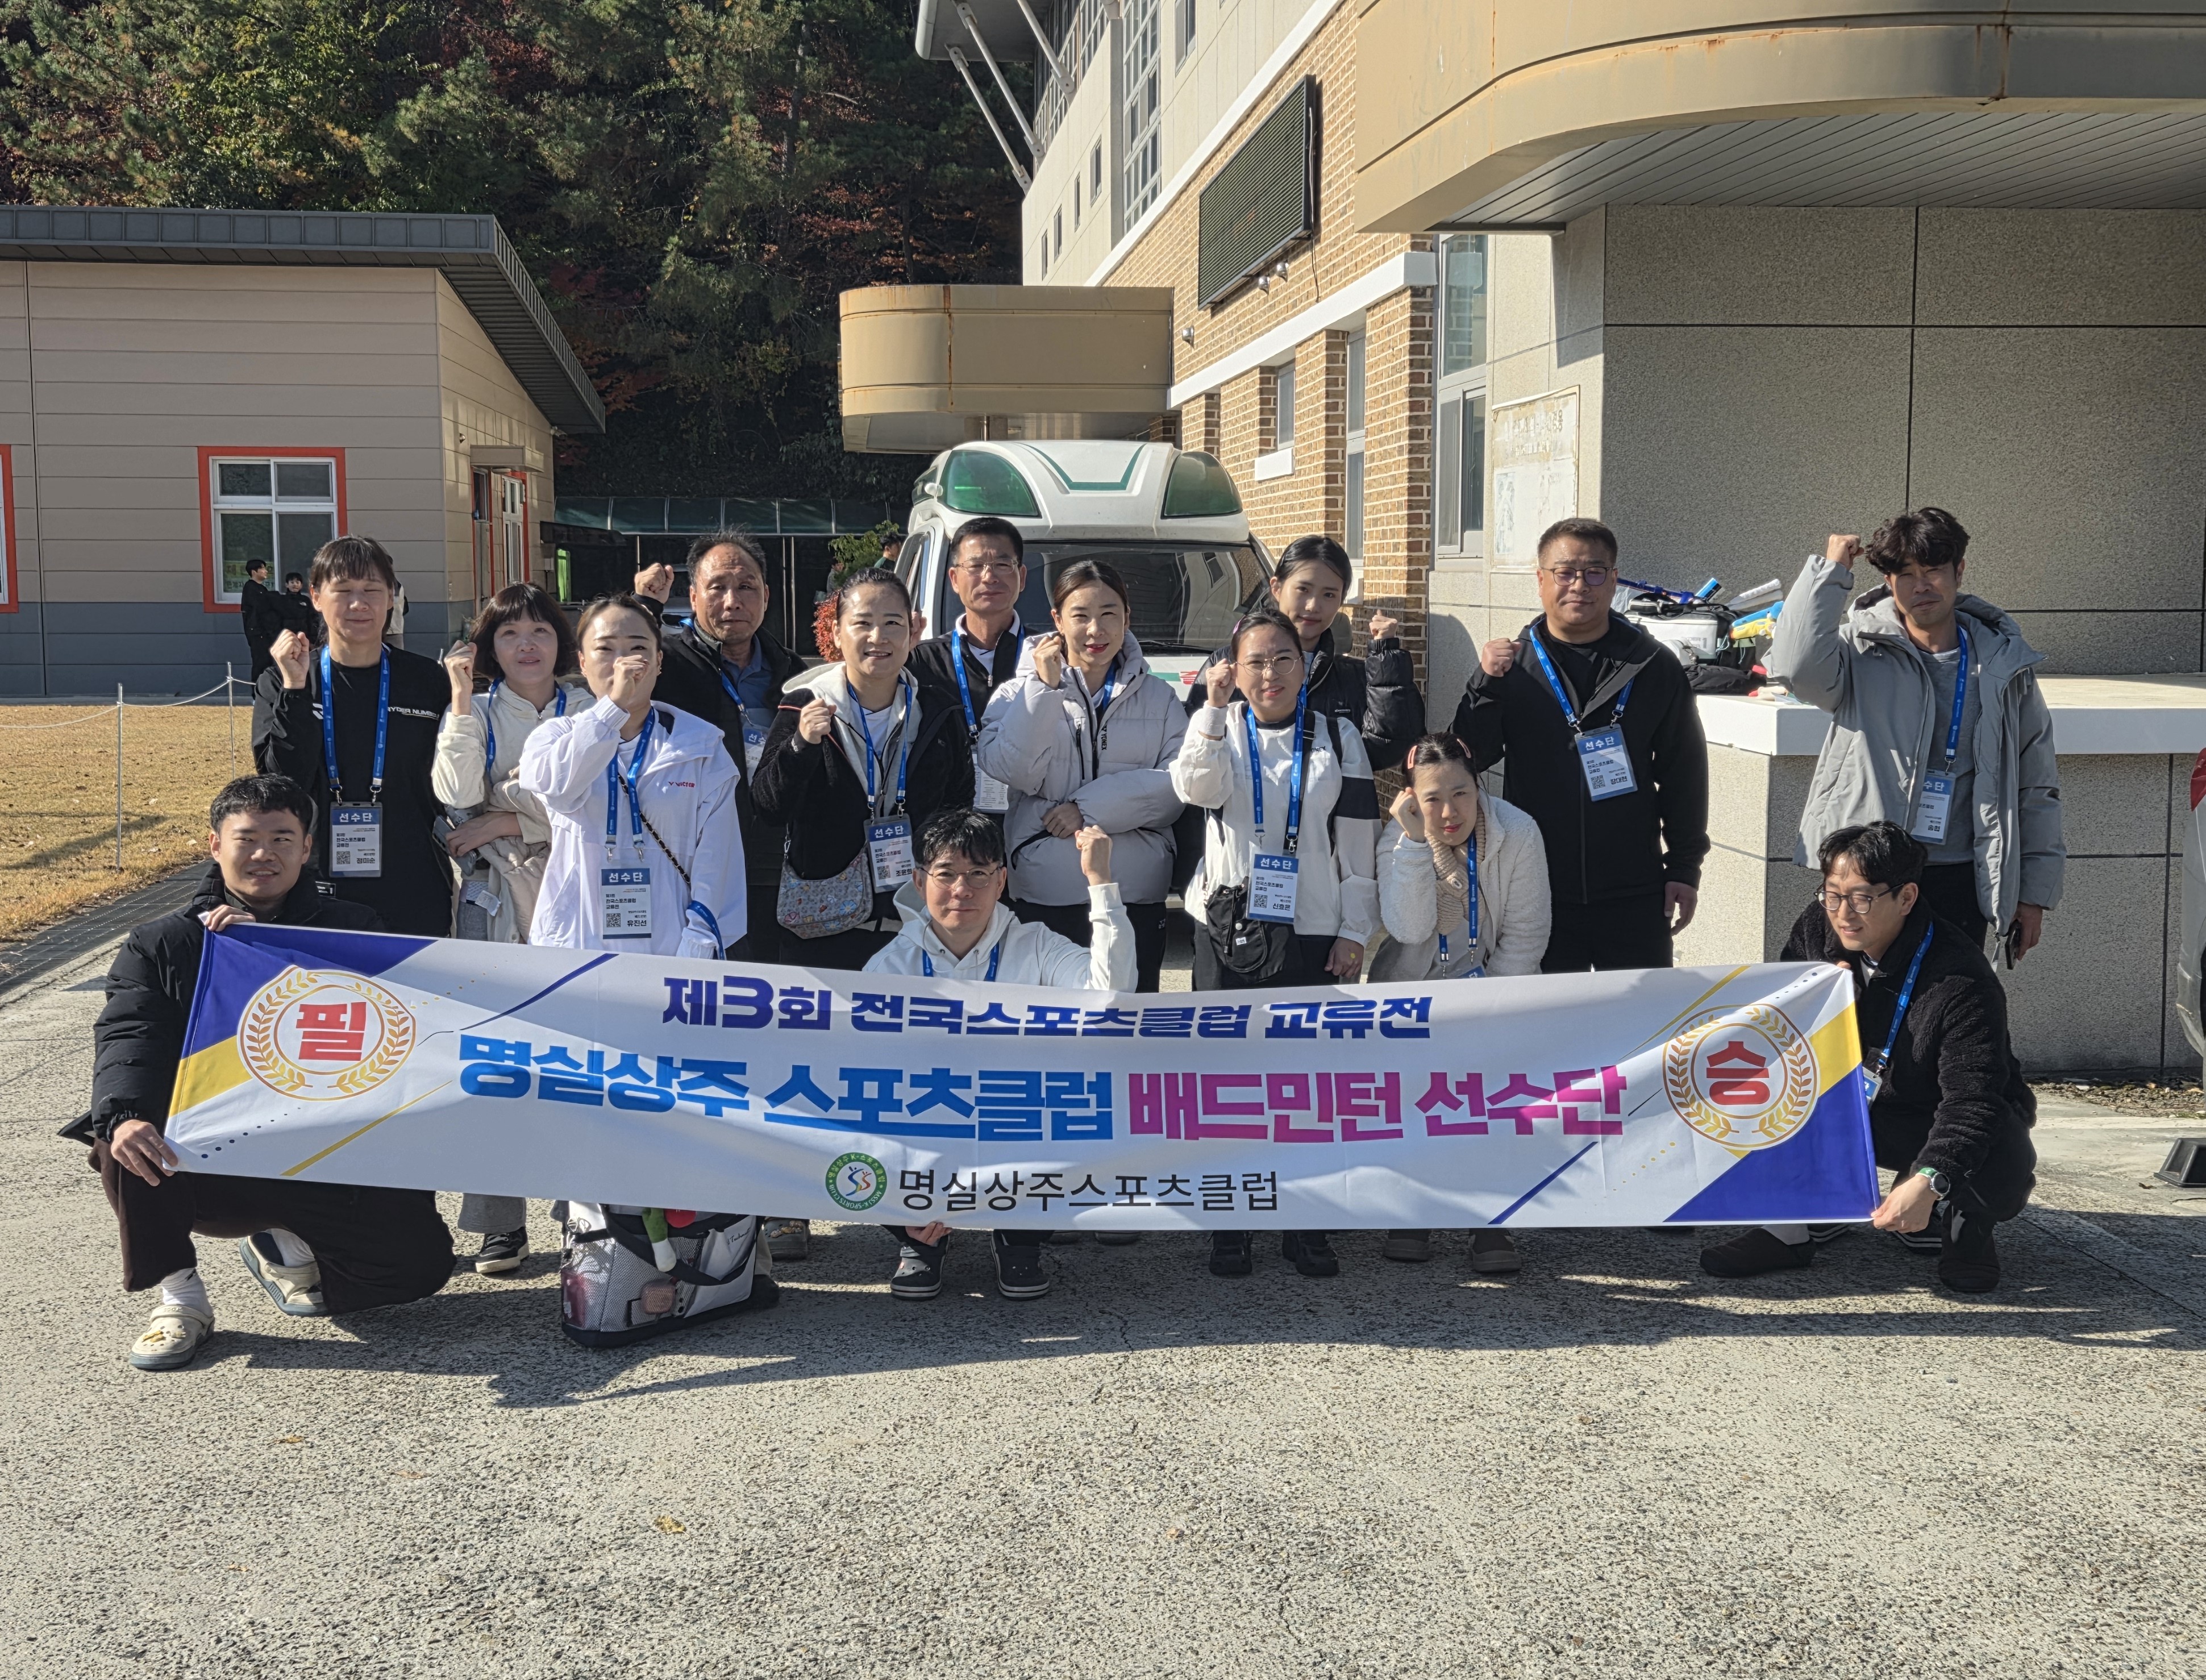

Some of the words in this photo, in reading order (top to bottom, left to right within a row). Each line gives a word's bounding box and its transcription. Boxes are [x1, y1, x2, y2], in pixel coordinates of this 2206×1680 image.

[1585, 736, 1614, 751] 선수단
[1924, 780, 1945, 791] 수단
[339, 813, 373, 822] 선수단
[875, 825, 904, 839] 선수단
[1260, 858, 1292, 870] 선수단
[609, 872, 643, 883] 선수단
[663, 975, 832, 1031] 제3회
[851, 992, 1252, 1039] 전국스포츠클럽
[1264, 996, 1433, 1039] 교류전
[295, 1001, 367, 1061] 필
[1706, 1041, 1770, 1105] 승
[459, 1034, 750, 1117] 명실상주
[764, 1064, 1113, 1142] 스포츠클럽
[1129, 1072, 1404, 1143] 배드민턴
[1414, 1064, 1628, 1137] 선수단
[899, 1169, 1277, 1212] 명실상주스포츠클럽
